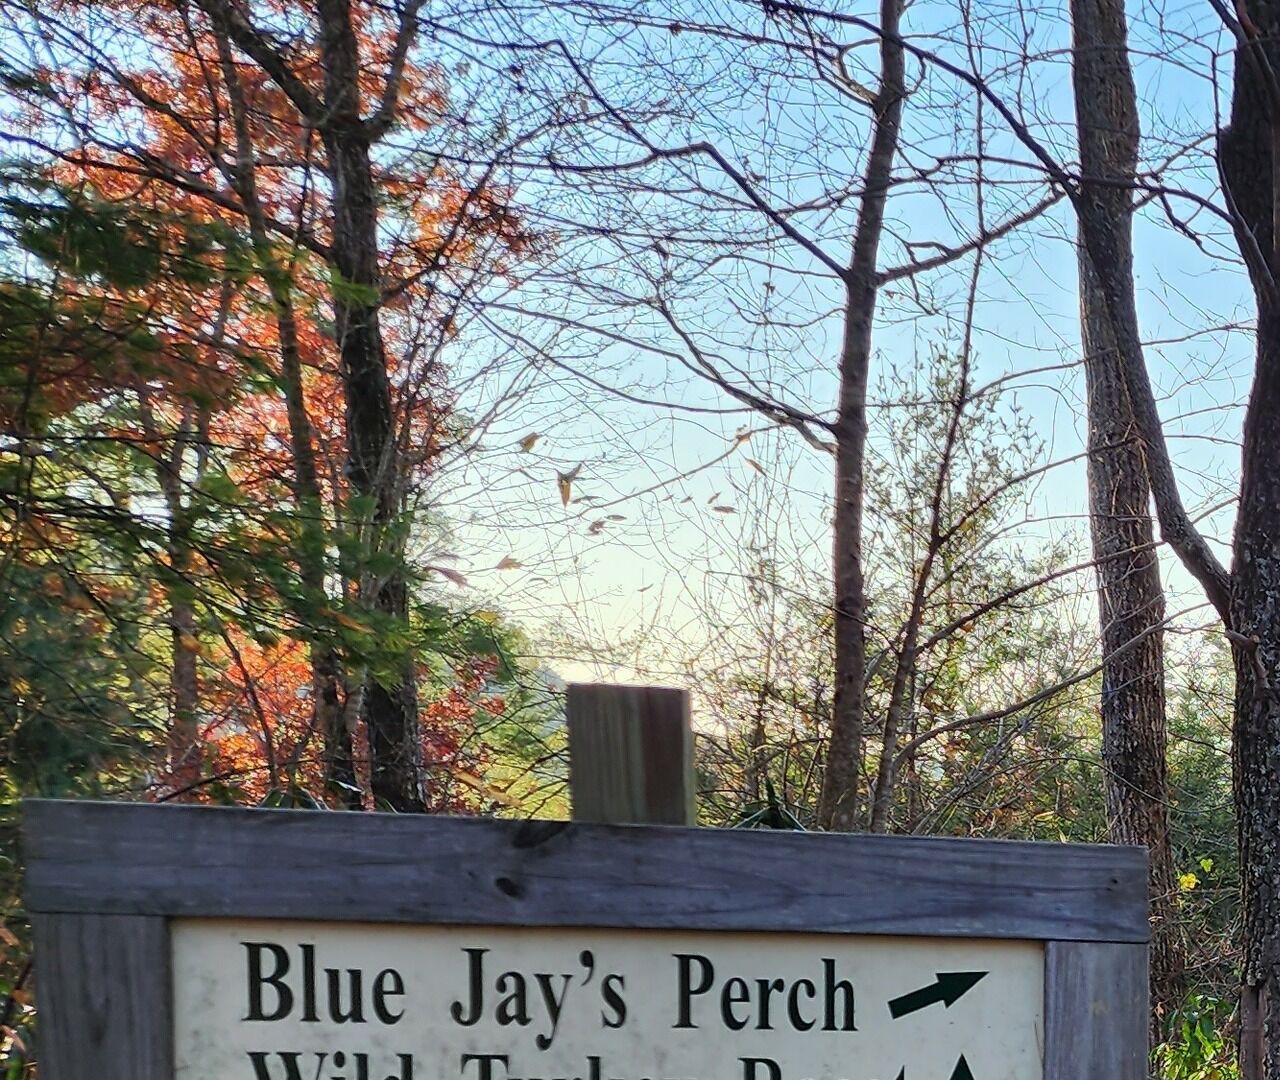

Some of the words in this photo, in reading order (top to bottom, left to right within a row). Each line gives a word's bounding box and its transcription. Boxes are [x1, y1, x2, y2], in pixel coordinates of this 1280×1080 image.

[240, 941, 407, 1024] Blue
[449, 946, 628, 1050] Jay's
[671, 952, 859, 1032] Perch
